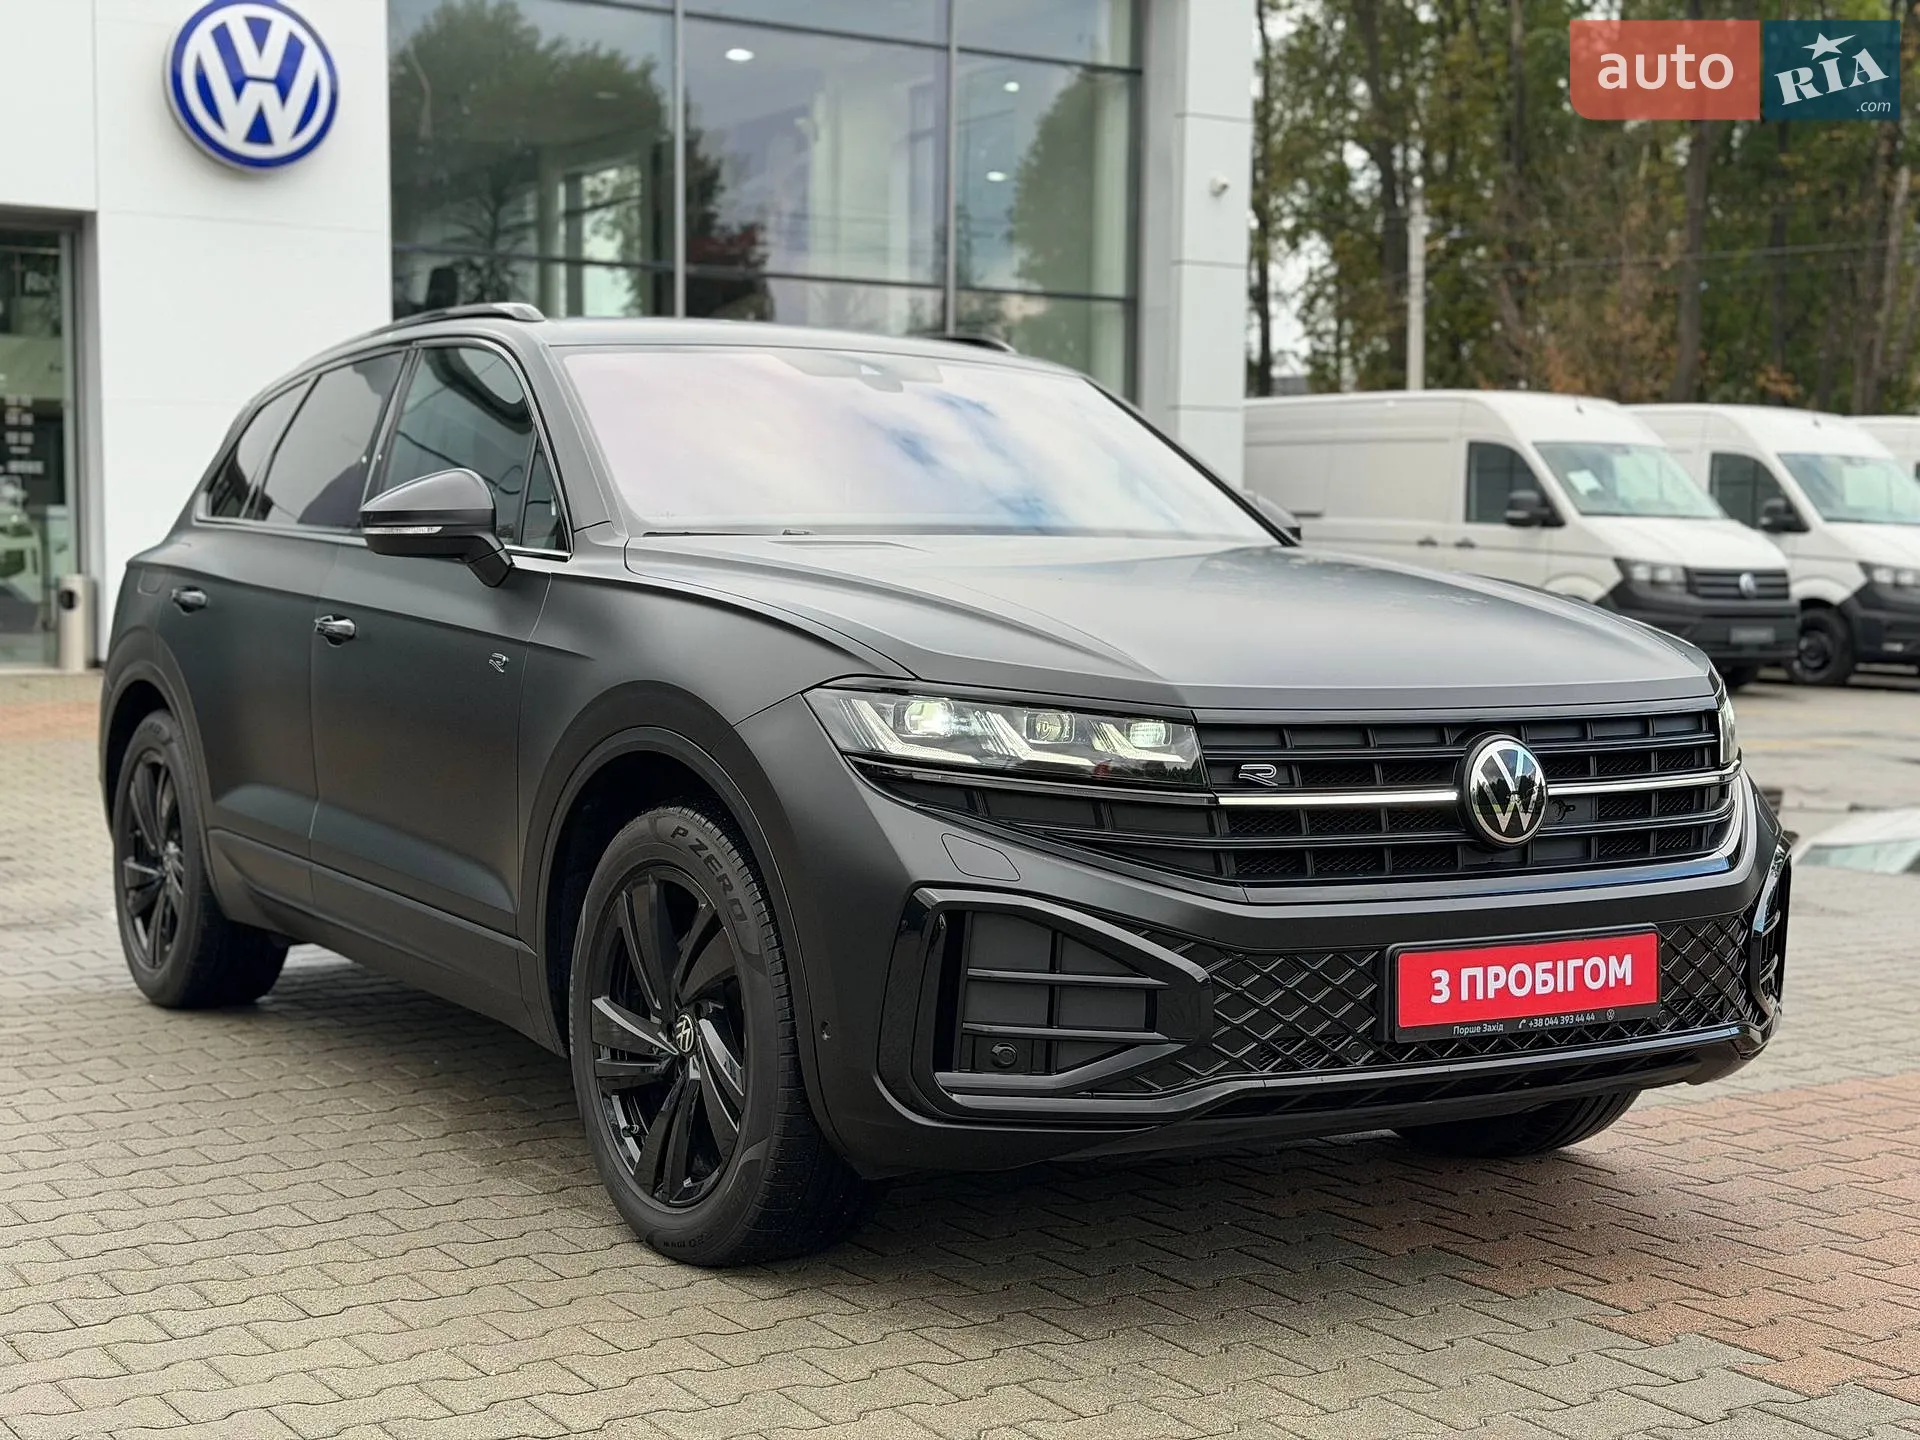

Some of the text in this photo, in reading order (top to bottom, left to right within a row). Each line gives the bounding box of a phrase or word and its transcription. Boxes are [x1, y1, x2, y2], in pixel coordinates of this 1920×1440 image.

[670, 825, 748, 922] P ZERO
[1430, 954, 1632, 1004] З ПРОБІГОМ
[1453, 1022, 1504, 1035] Порше Захід
[1528, 1012, 1596, 1028] +38 044 393 44 44
